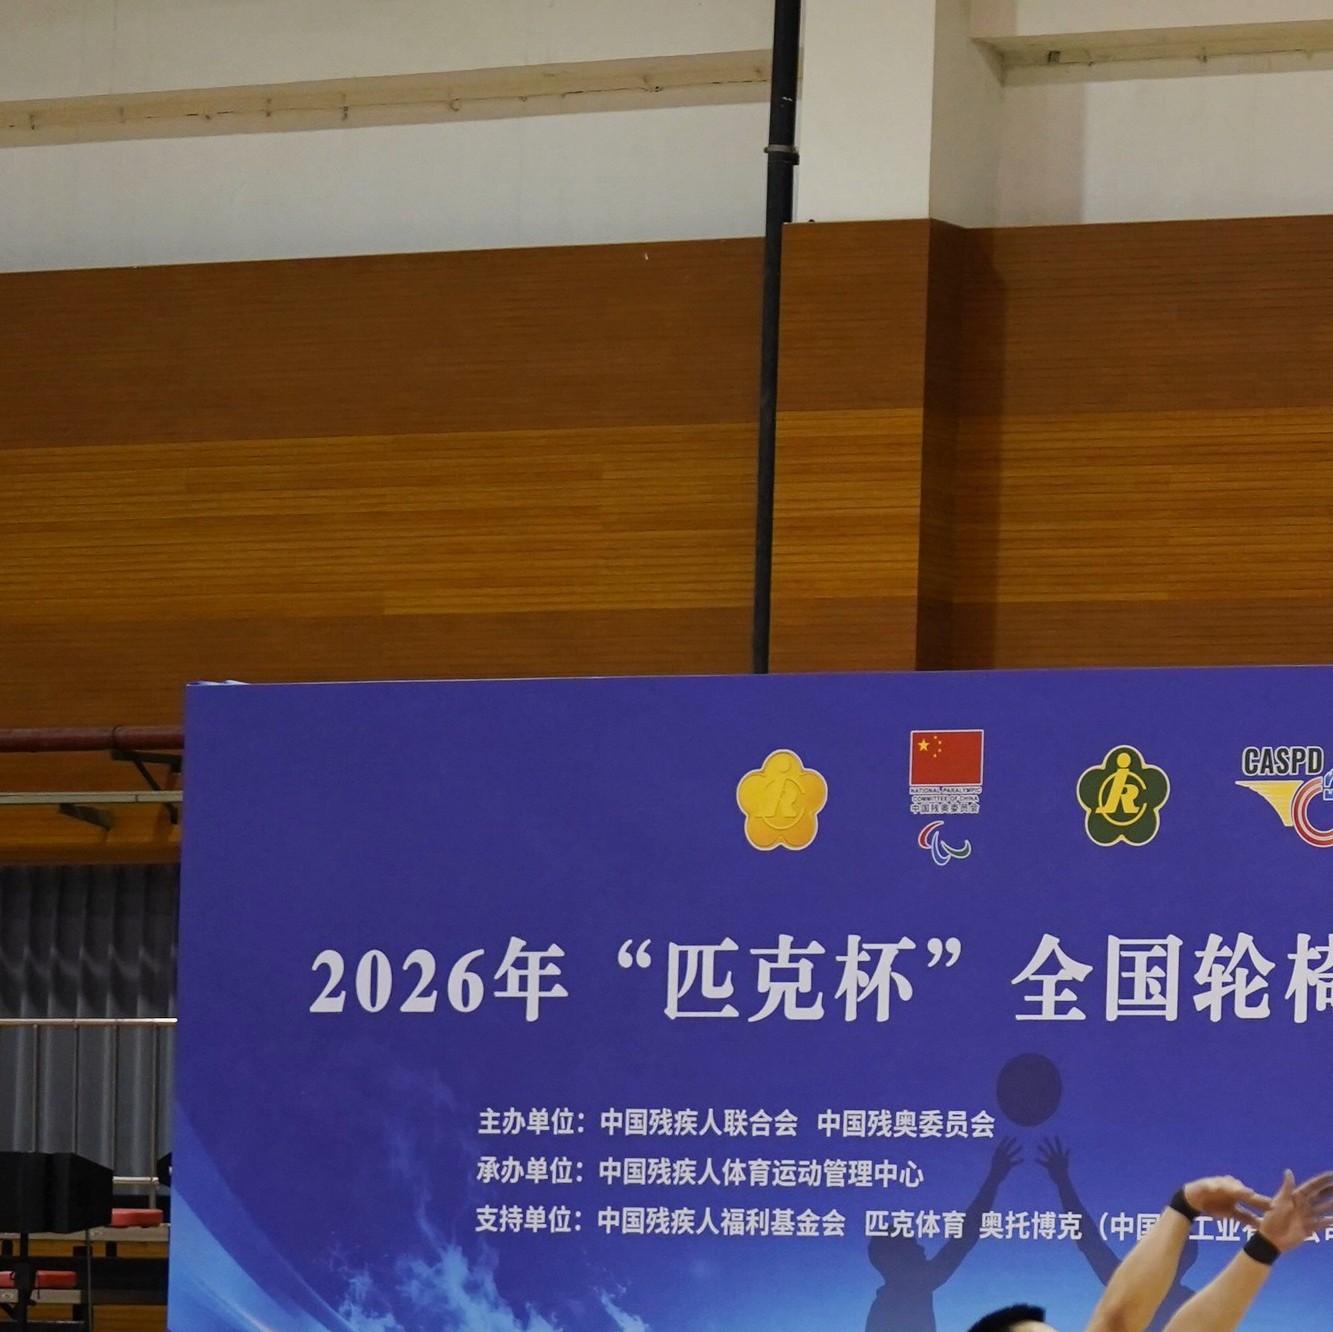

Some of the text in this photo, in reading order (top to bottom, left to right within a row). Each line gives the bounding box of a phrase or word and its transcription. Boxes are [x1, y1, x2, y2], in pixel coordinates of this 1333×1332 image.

[1242, 746, 1324, 776] CASPD
[309, 937, 569, 1022] 2026年
[617, 933, 962, 1022] “匹克杯”
[478, 1107, 995, 1138] 主办单位：中国残疾人联合会 中国残奥委员会
[476, 1156, 924, 1188] 承办单位：中国残疾人体育运动管理中心
[475, 1205, 846, 1237] 支持单位：中国残疾人福利基金会
[865, 1210, 967, 1239] 匹克体育
